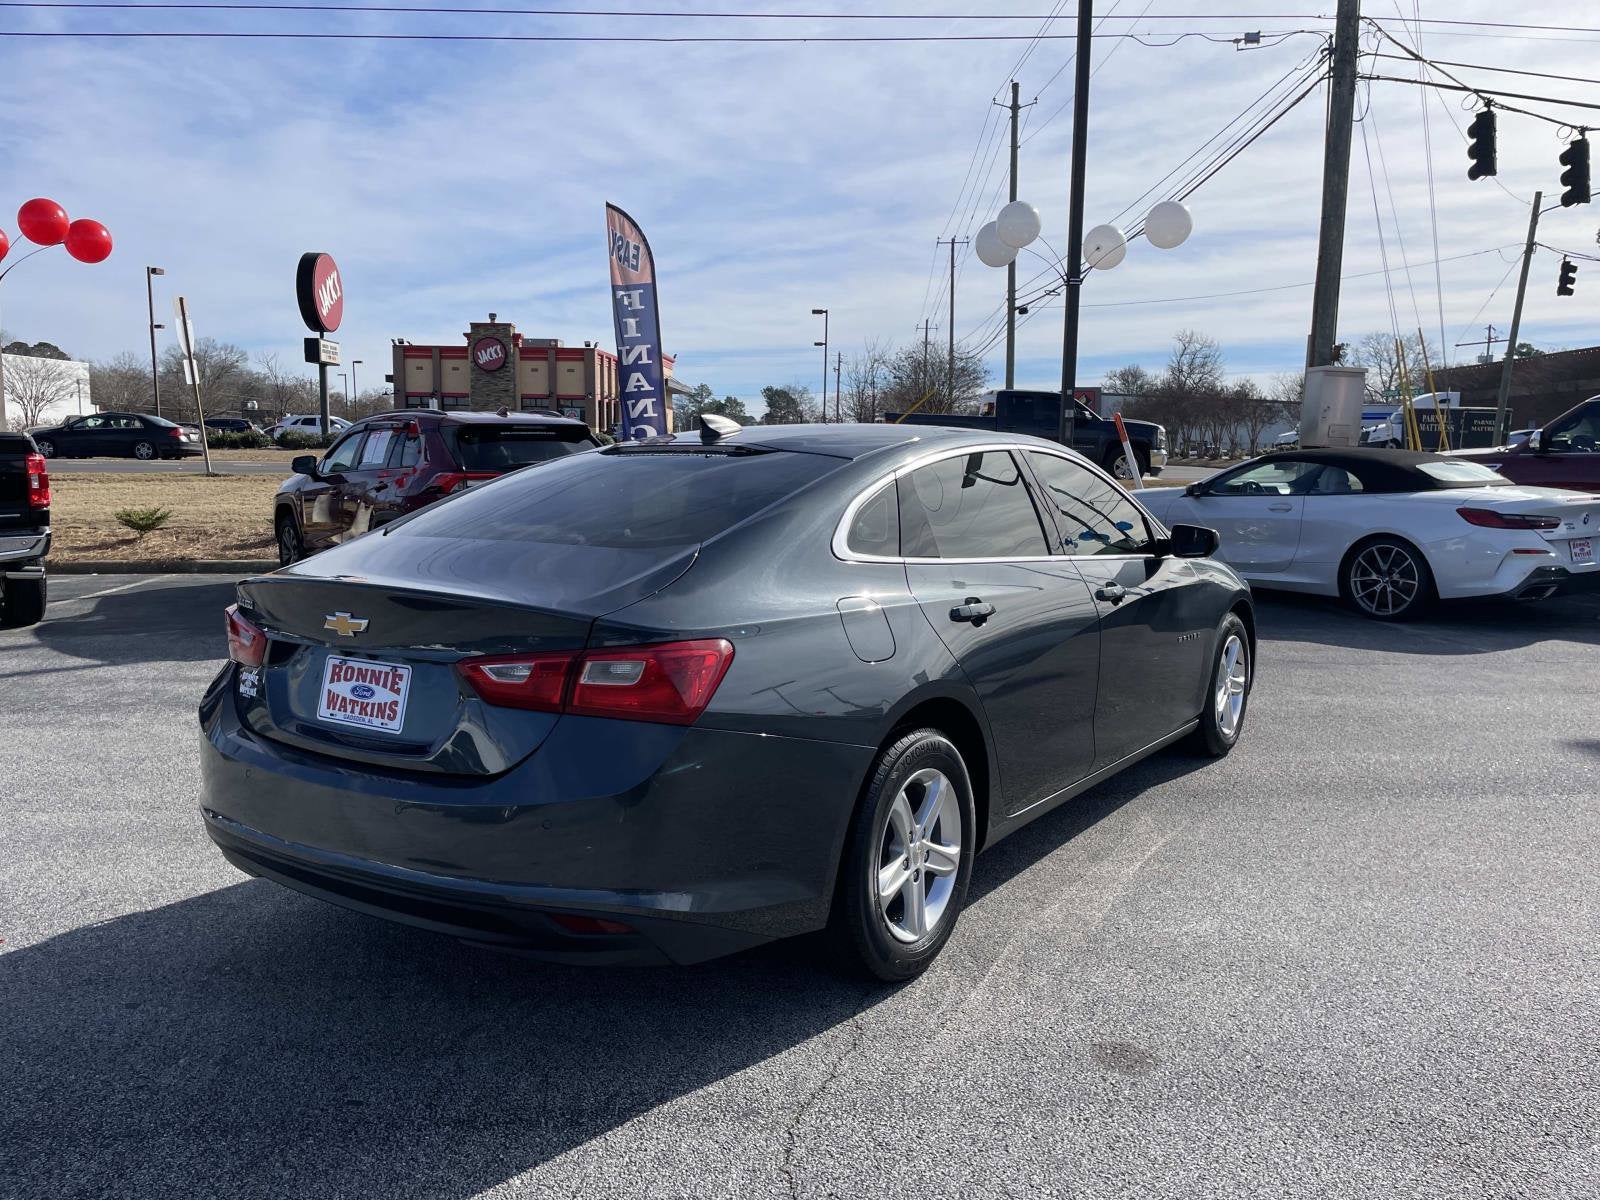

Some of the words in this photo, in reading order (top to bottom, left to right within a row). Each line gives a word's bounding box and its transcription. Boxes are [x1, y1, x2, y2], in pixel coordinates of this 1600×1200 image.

[329, 663, 404, 696] RONNIE
[354, 687, 373, 697] Ford
[326, 688, 399, 721] WATKINS
